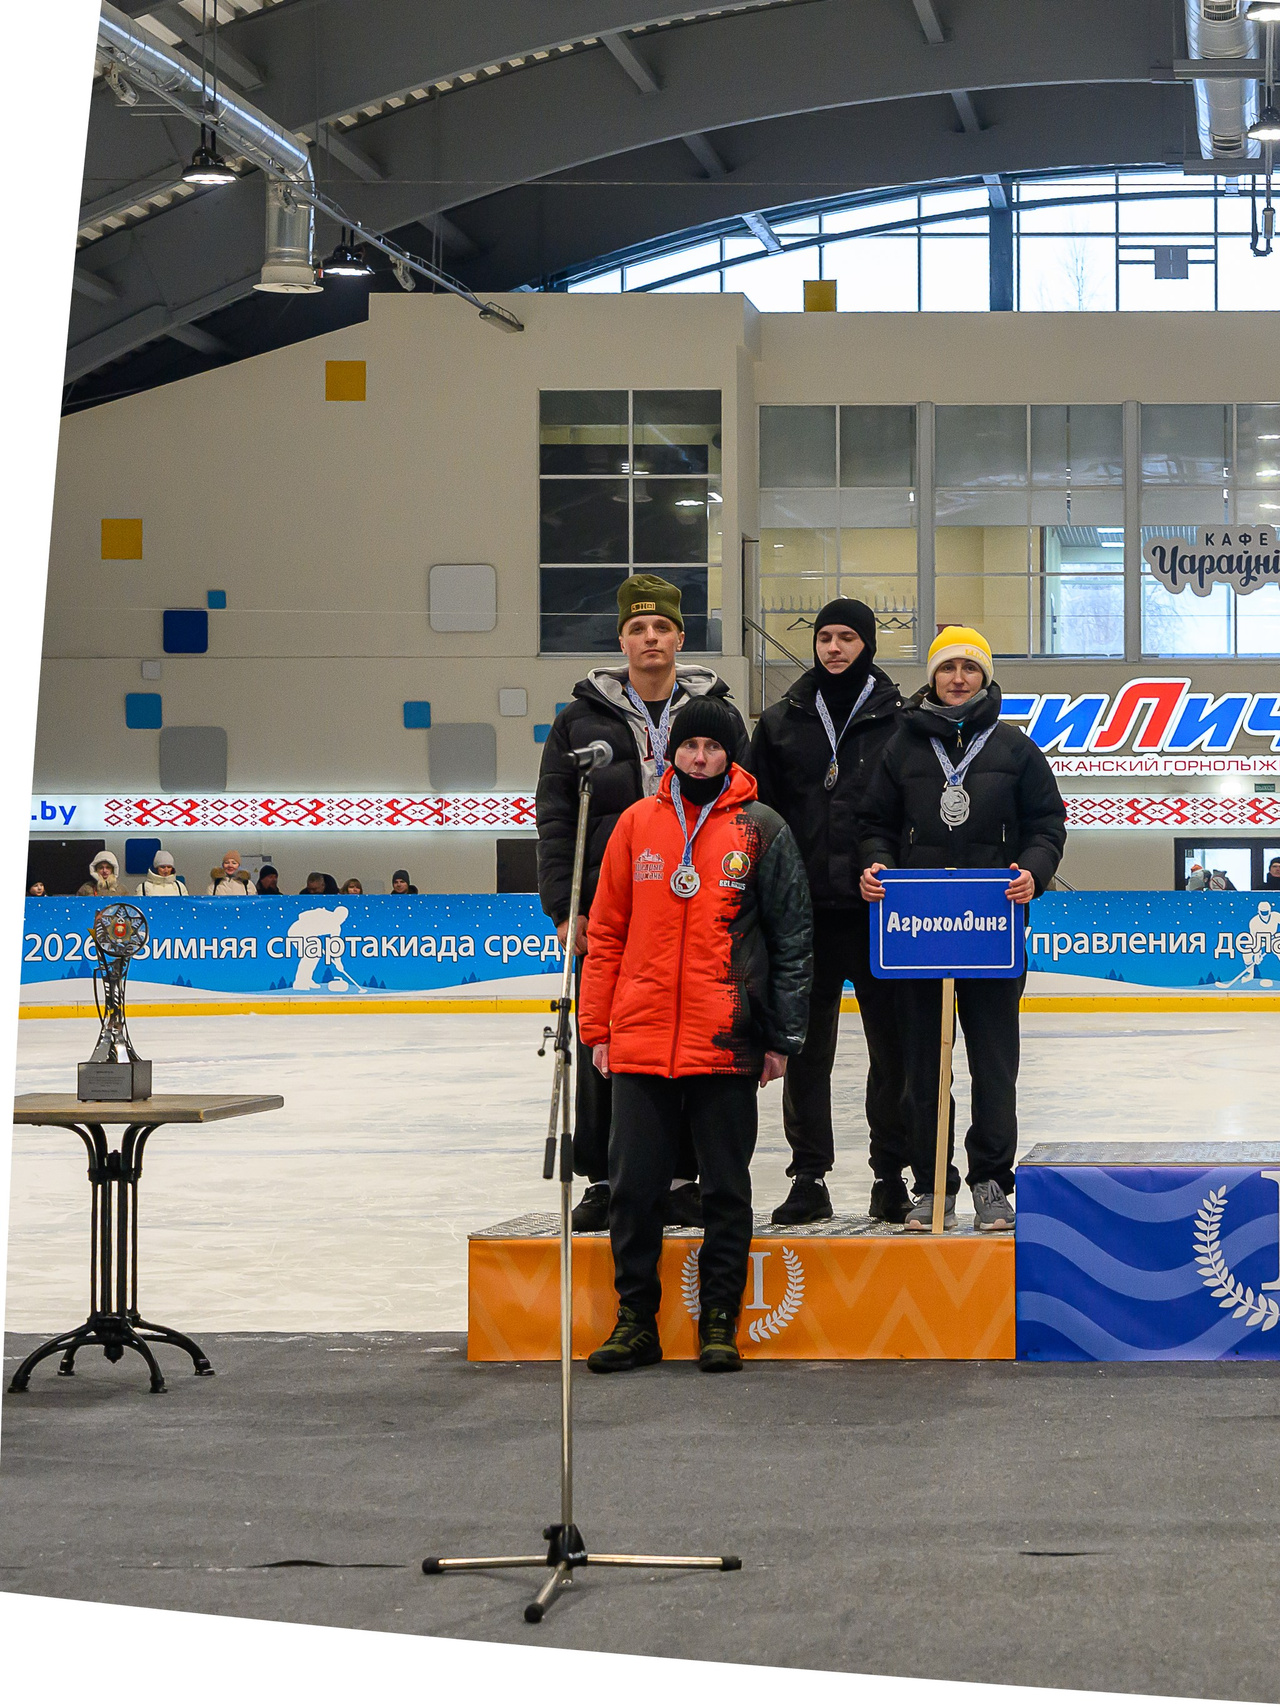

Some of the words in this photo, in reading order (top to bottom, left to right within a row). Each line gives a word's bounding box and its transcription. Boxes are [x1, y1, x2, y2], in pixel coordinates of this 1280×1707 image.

[1205, 532, 1268, 546] КАФЕ
[1050, 757, 1158, 772] ИКАНСКИЙ
[886, 910, 1008, 938] Агрохолдинг
[266, 935, 475, 965] спартакиада
[484, 935, 566, 964] сред
[746, 1251, 772, 1309] I
